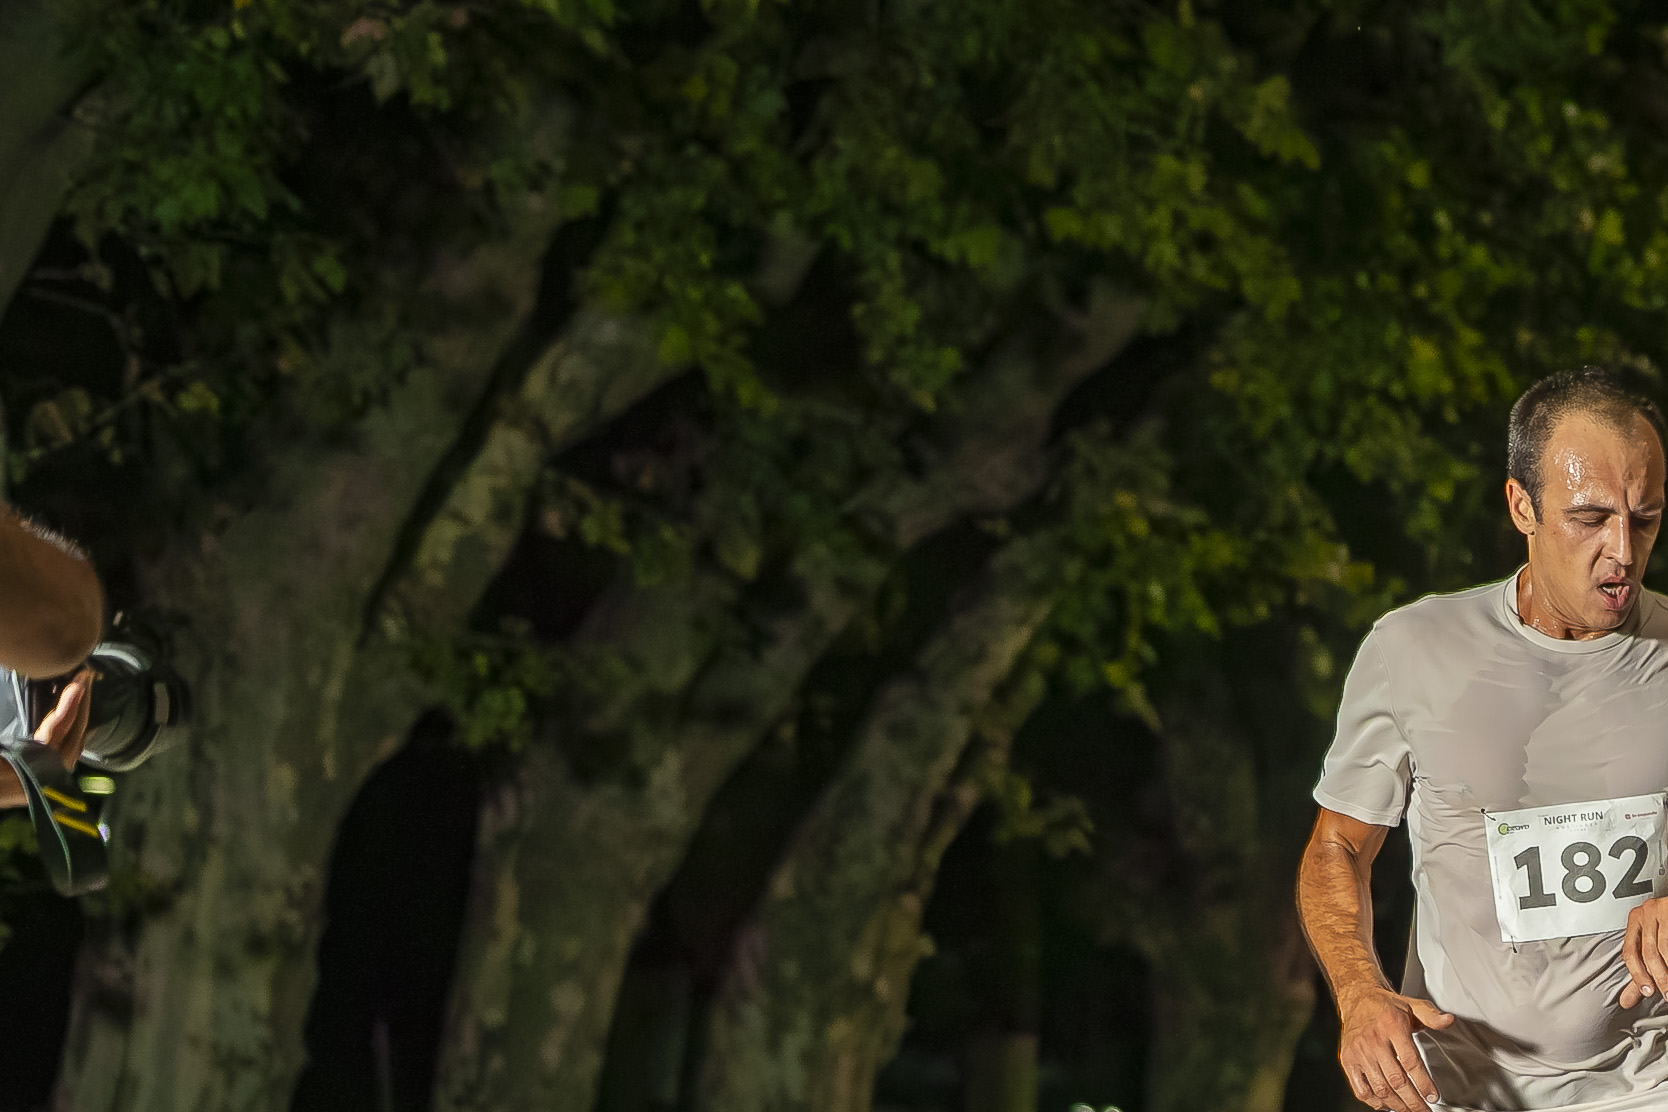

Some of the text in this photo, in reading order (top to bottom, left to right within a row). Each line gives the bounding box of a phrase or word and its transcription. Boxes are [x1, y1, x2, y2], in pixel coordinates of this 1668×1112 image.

[1543, 811, 1604, 826] NIGHT RUN
[1513, 835, 1653, 910] 182
